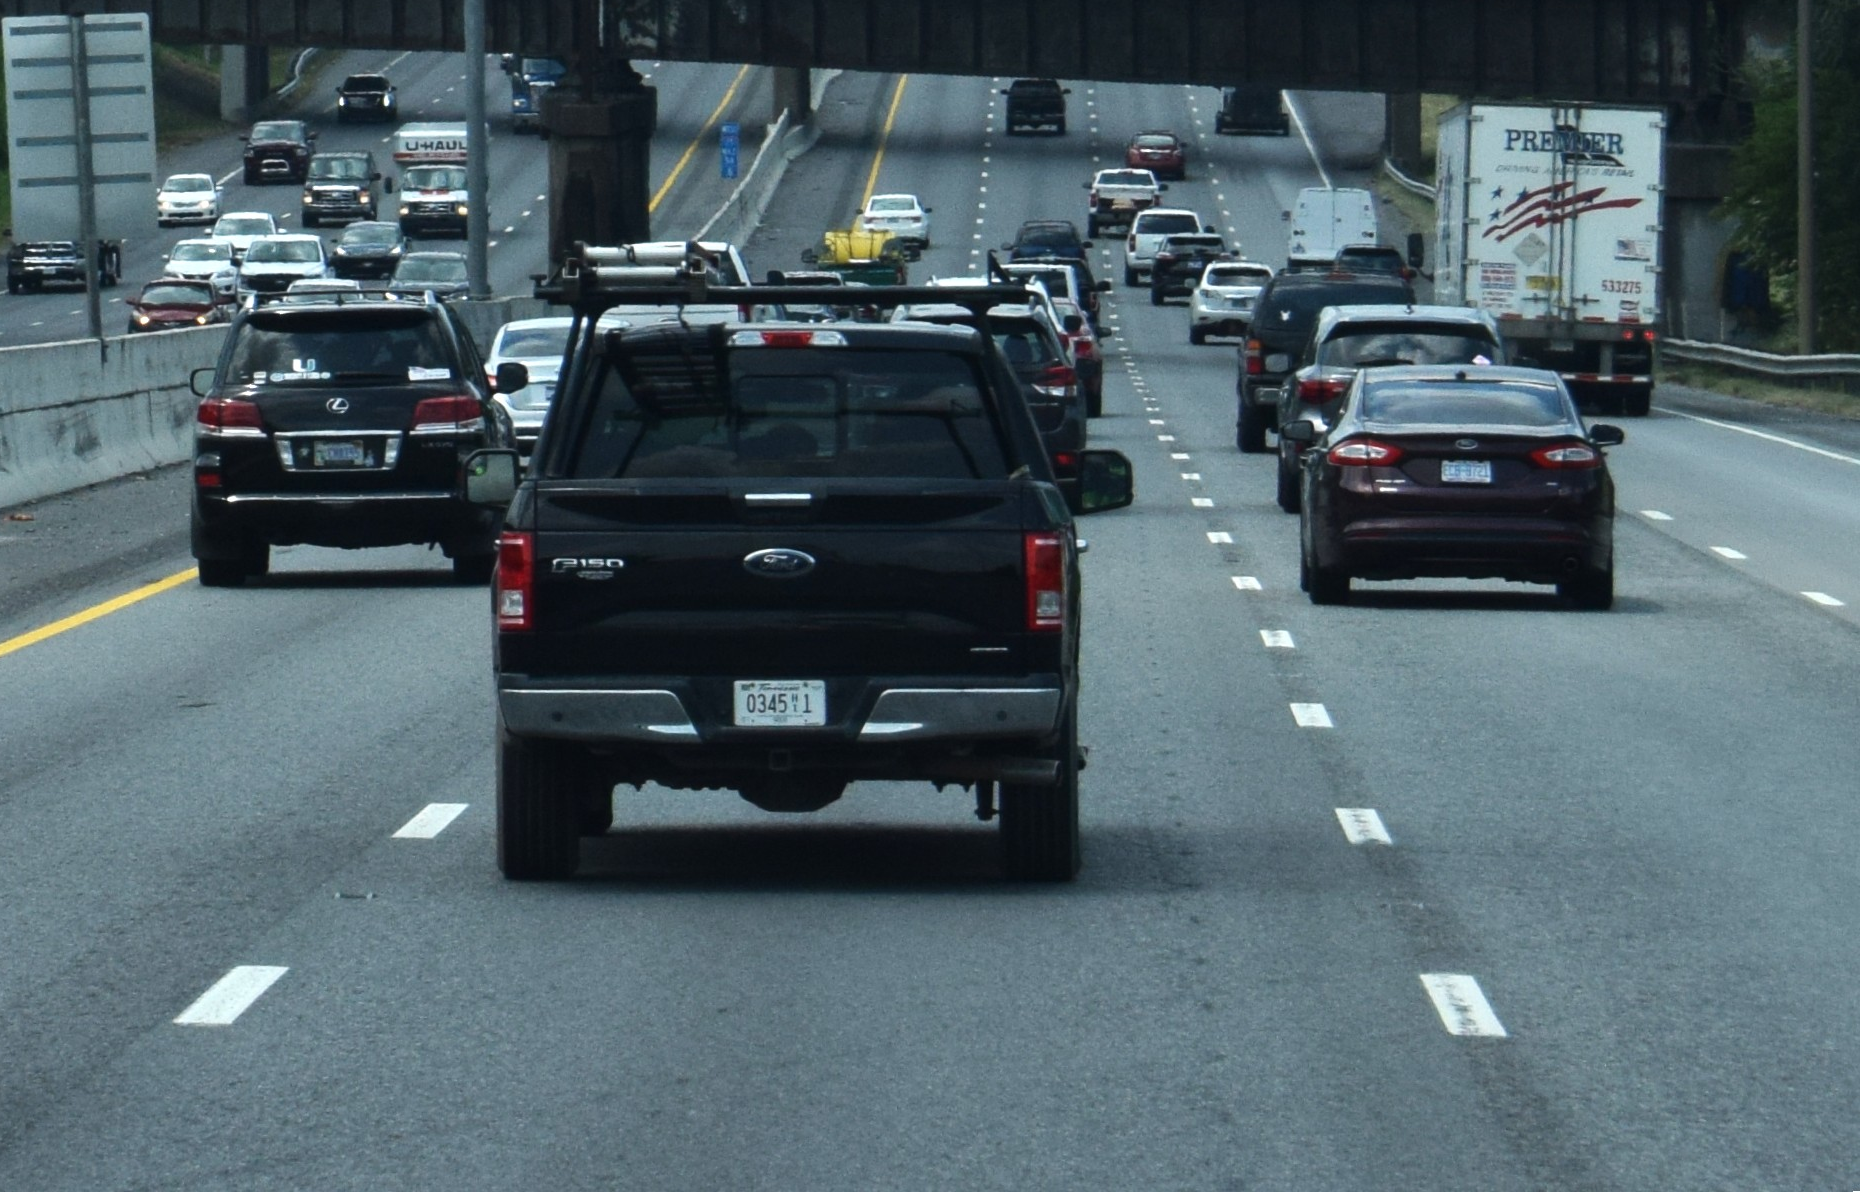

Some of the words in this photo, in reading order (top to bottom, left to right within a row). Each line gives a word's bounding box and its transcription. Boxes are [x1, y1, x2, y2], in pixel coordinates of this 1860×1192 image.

[1504, 129, 1624, 155] PREMIER
[1601, 279, 1642, 295] 533275
[747, 693, 788, 713] 0345
